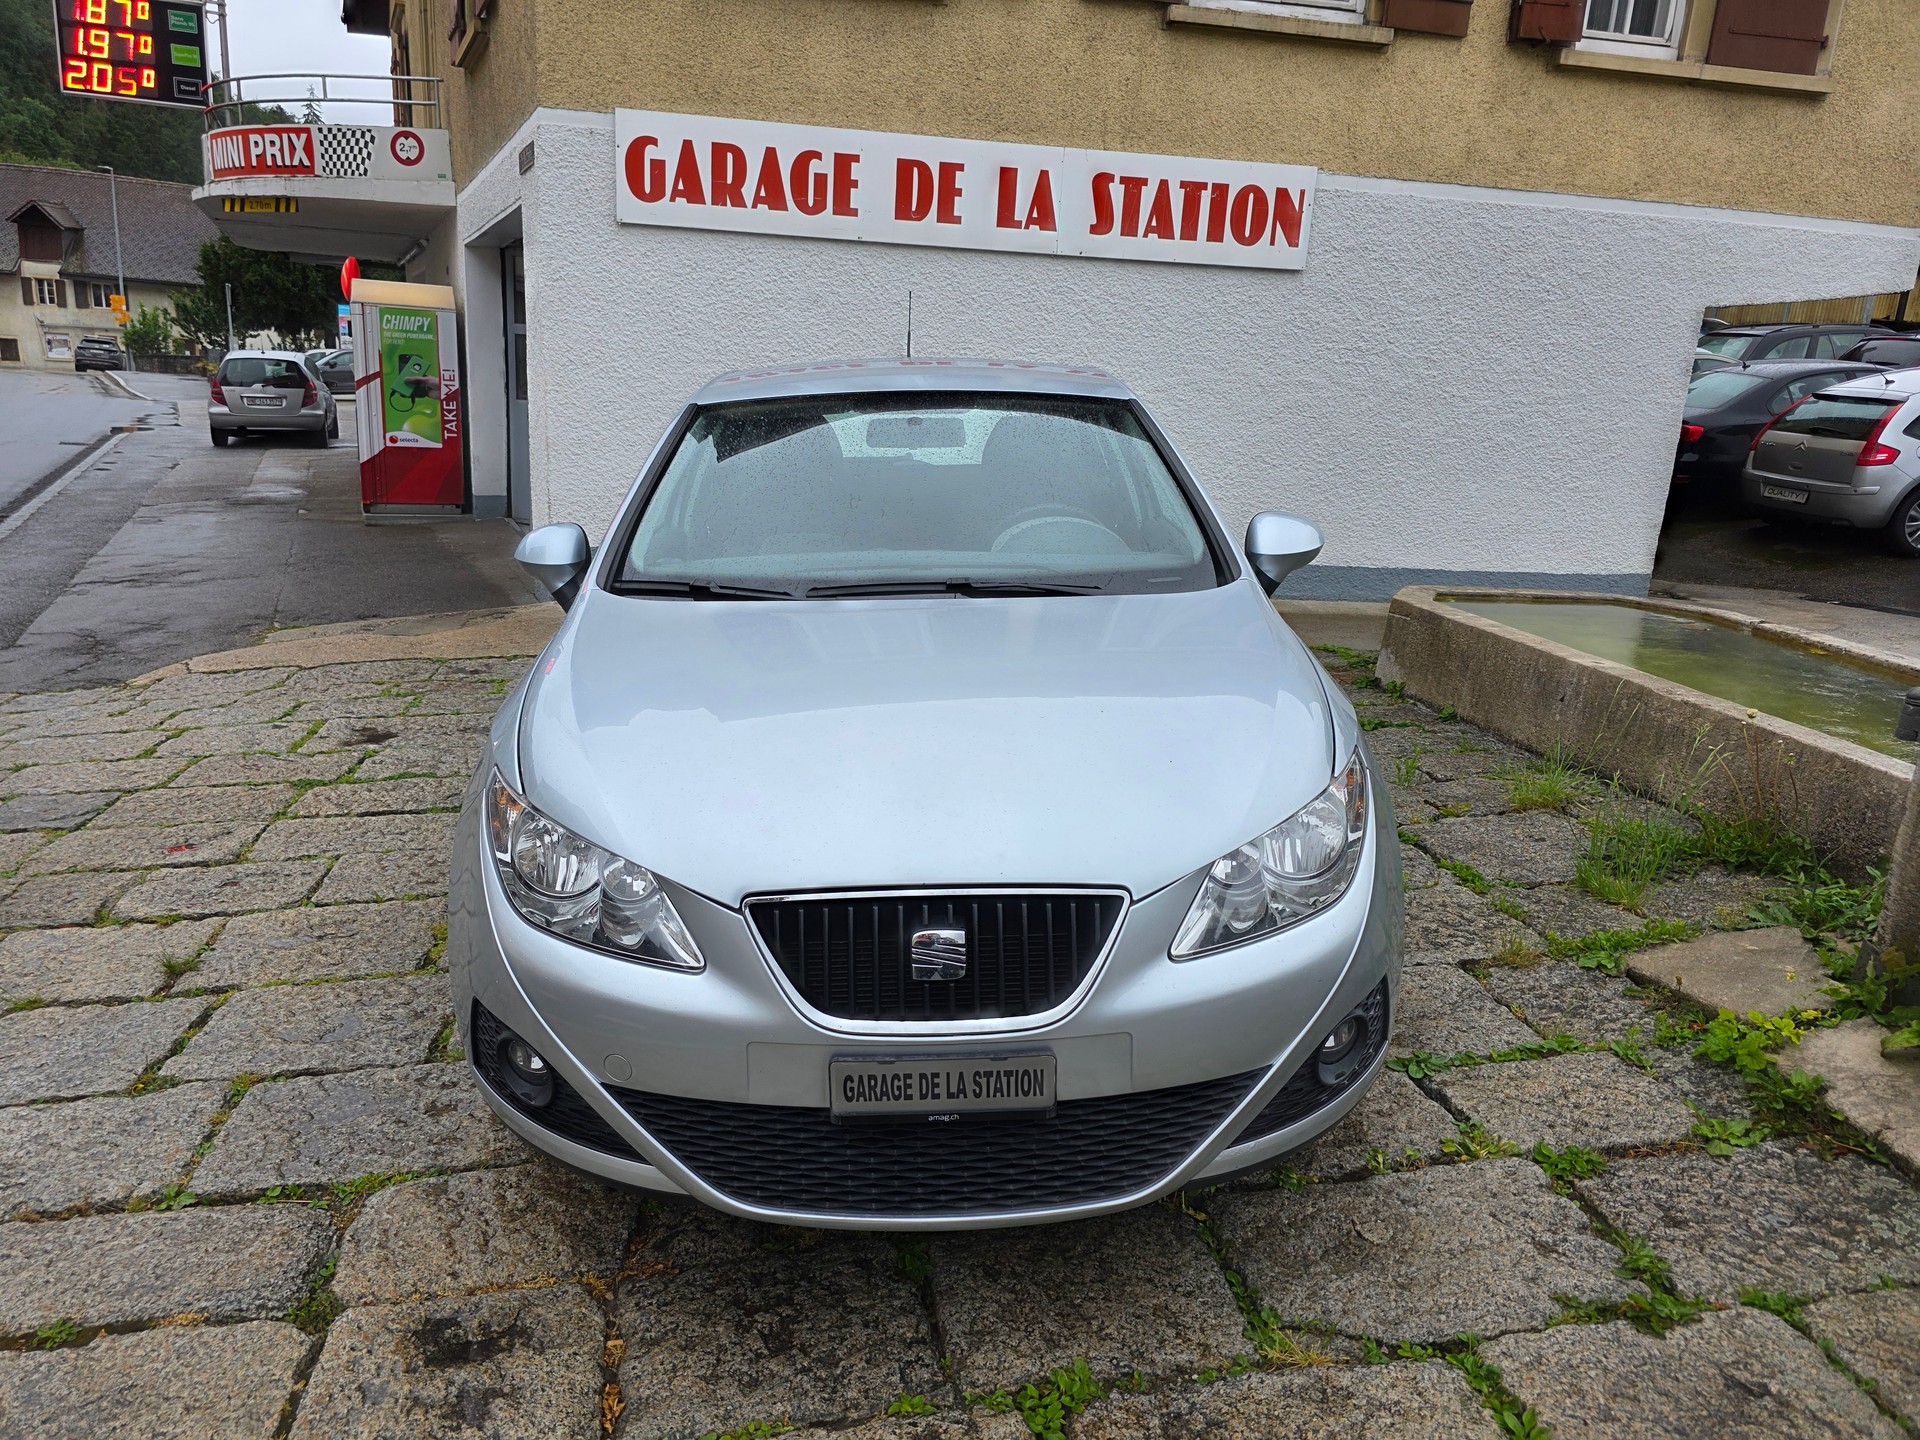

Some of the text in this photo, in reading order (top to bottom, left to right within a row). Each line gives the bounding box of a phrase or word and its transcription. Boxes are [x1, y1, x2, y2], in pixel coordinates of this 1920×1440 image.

[212, 132, 312, 171] MINI PRIX
[624, 135, 1306, 248] GARAGE DE LA STATION
[382, 314, 431, 332] CHIMPY
[442, 368, 458, 440] TAKE ME!
[399, 436, 419, 444] selecta
[1767, 488, 1802, 499] QUALITY
[843, 1068, 1045, 1104] GARAGE DE LA STATION
[927, 1113, 960, 1122] amag.ch
